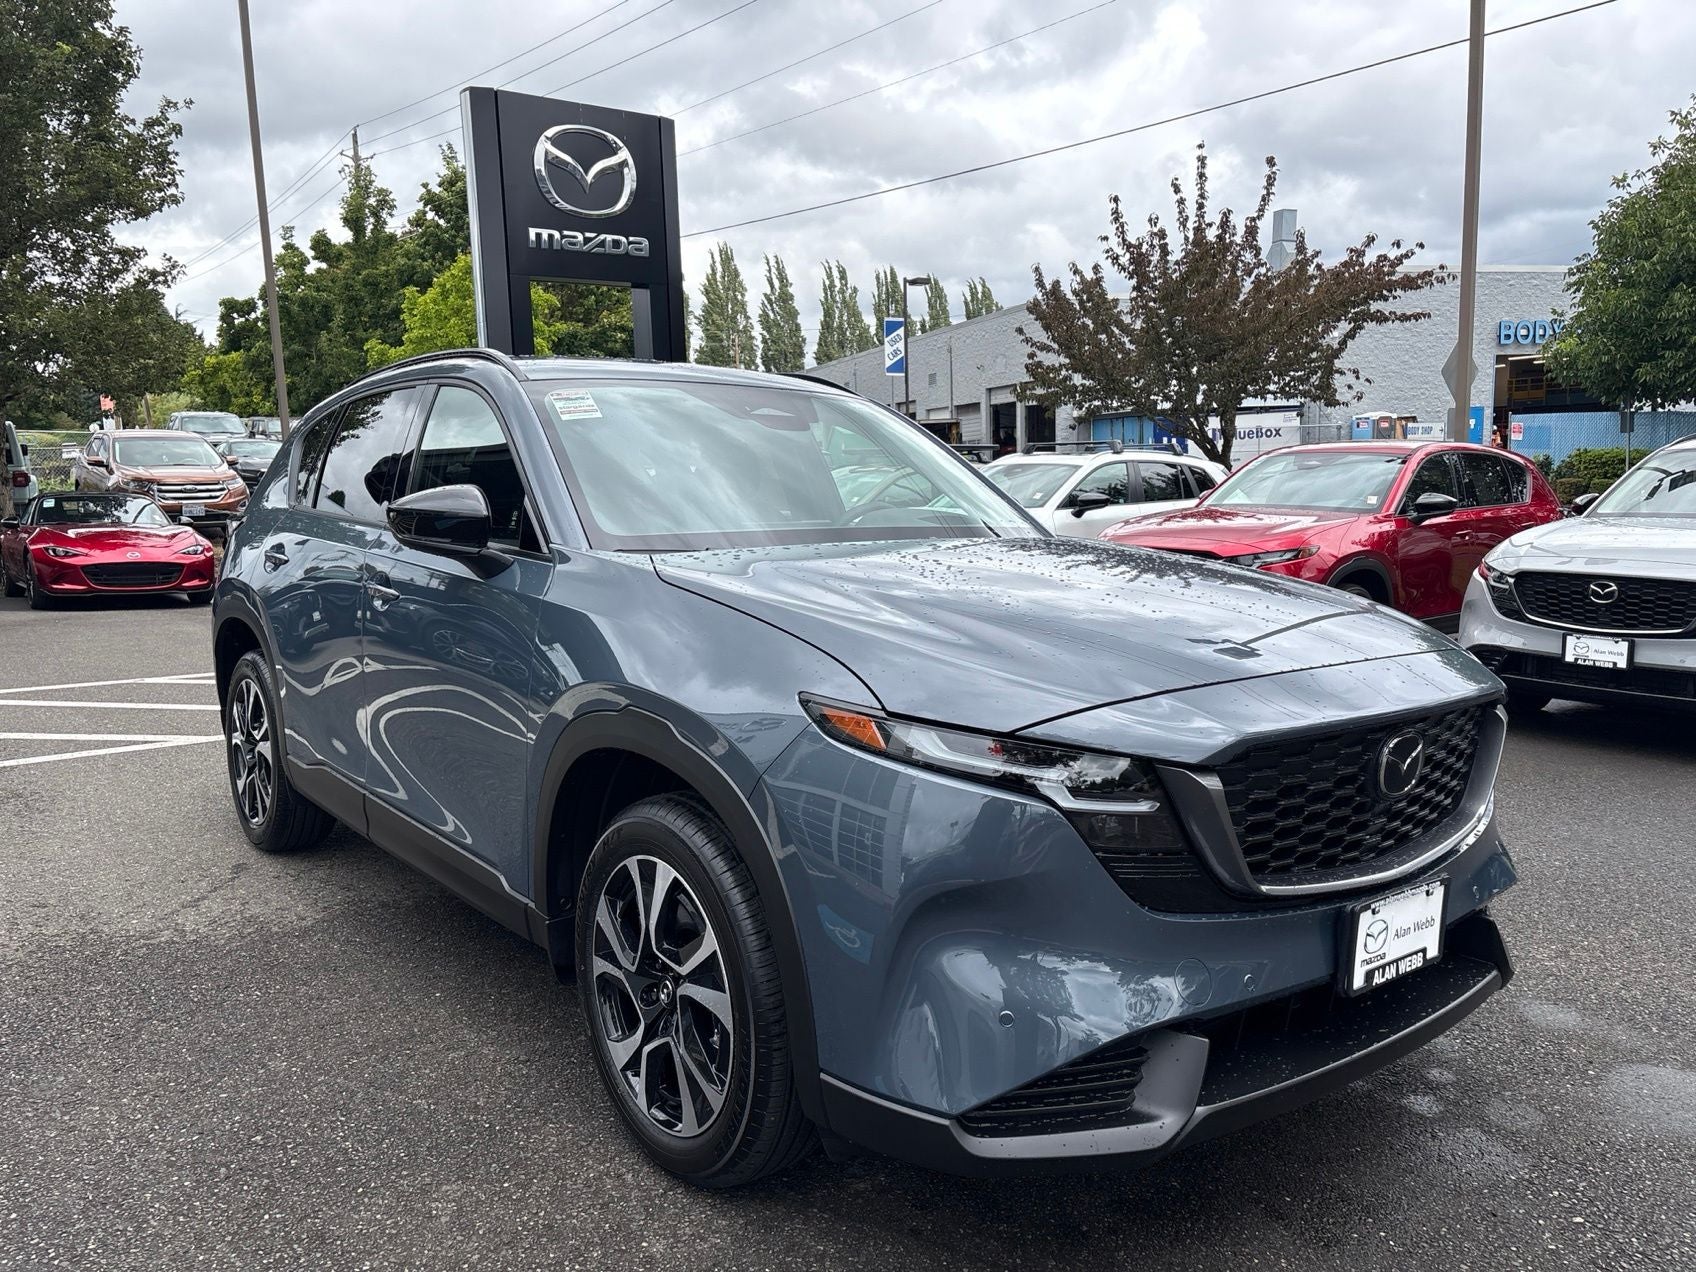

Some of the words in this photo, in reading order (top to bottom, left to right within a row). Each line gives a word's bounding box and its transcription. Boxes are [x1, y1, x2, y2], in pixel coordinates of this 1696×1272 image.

[1499, 318, 1564, 345] BODY
[887, 333, 903, 347] USED
[887, 347, 903, 361] CARS
[1408, 426, 1419, 435] BODY
[1421, 426, 1433, 435] SHOP
[1593, 648, 1607, 656] Alan
[1576, 658, 1594, 666] ALAN
[1594, 660, 1613, 668] WEBB
[1392, 926, 1411, 941] Alan
[1413, 915, 1435, 933] Webb
[1372, 962, 1397, 986] ALAN
[1397, 951, 1424, 975] WEBB
